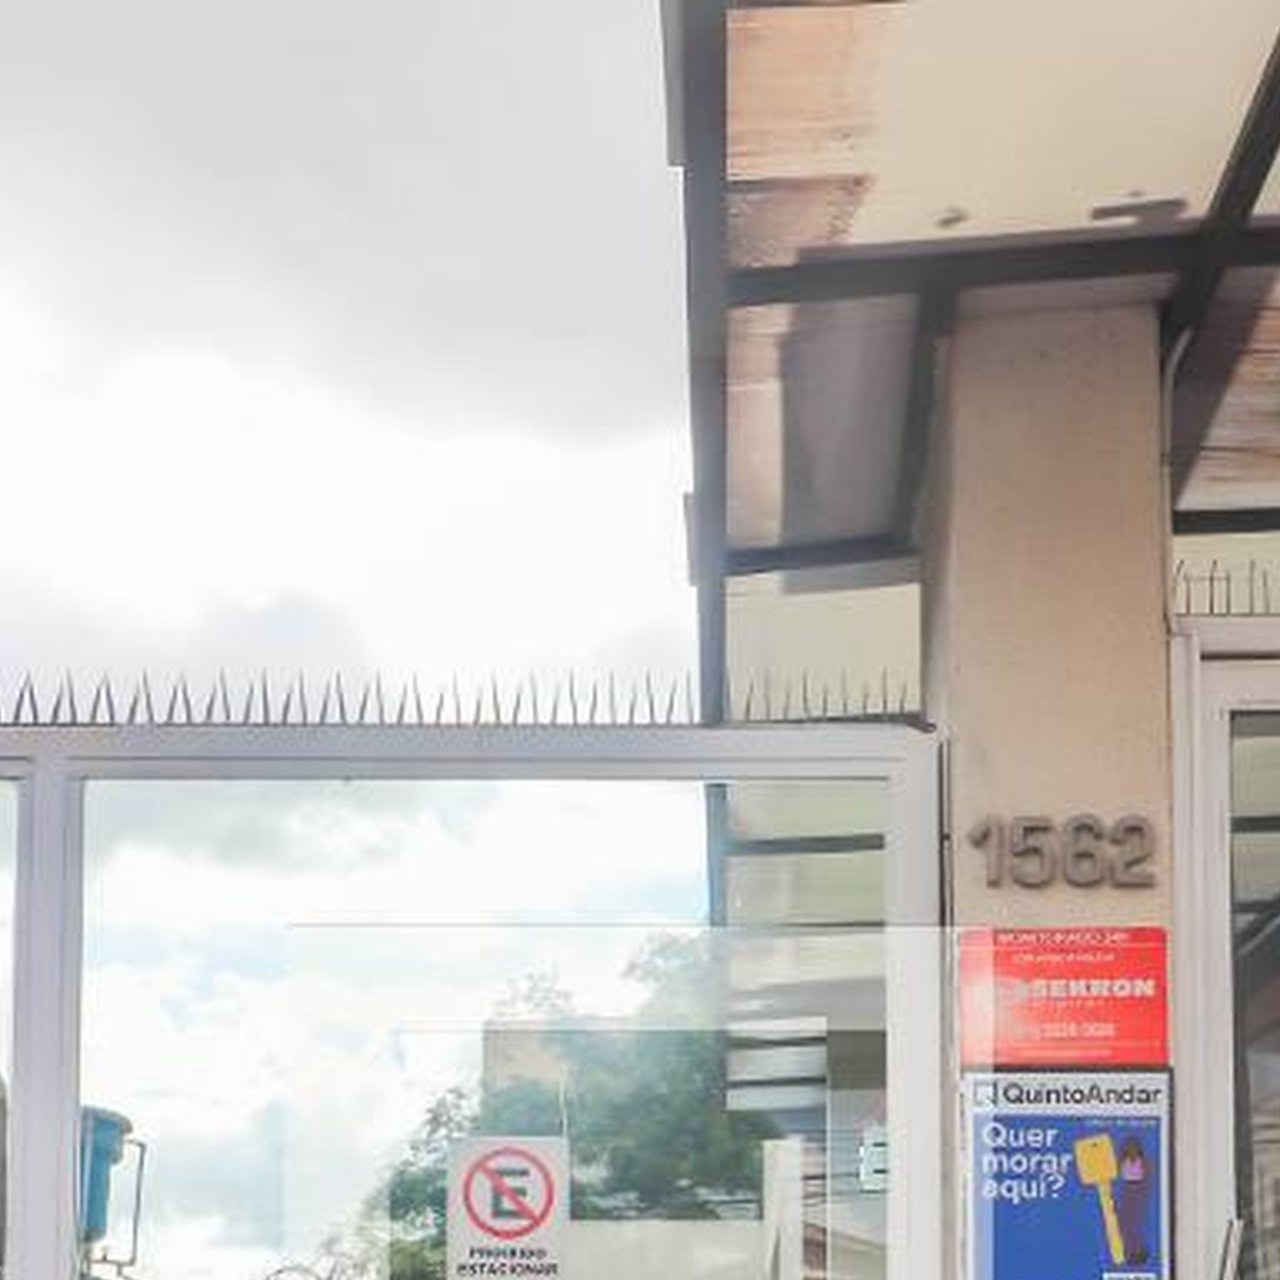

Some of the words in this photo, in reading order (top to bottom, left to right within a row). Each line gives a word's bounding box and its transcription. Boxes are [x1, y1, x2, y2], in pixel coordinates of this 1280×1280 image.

[971, 813, 1156, 889] 1562
[1002, 1082, 1163, 1105] QuintoAndar
[982, 1121, 1059, 1148] Quer
[982, 1152, 1073, 1174] morar
[982, 1174, 1065, 1205] aqui?
[457, 1262, 558, 1277] ESTACIONAR
